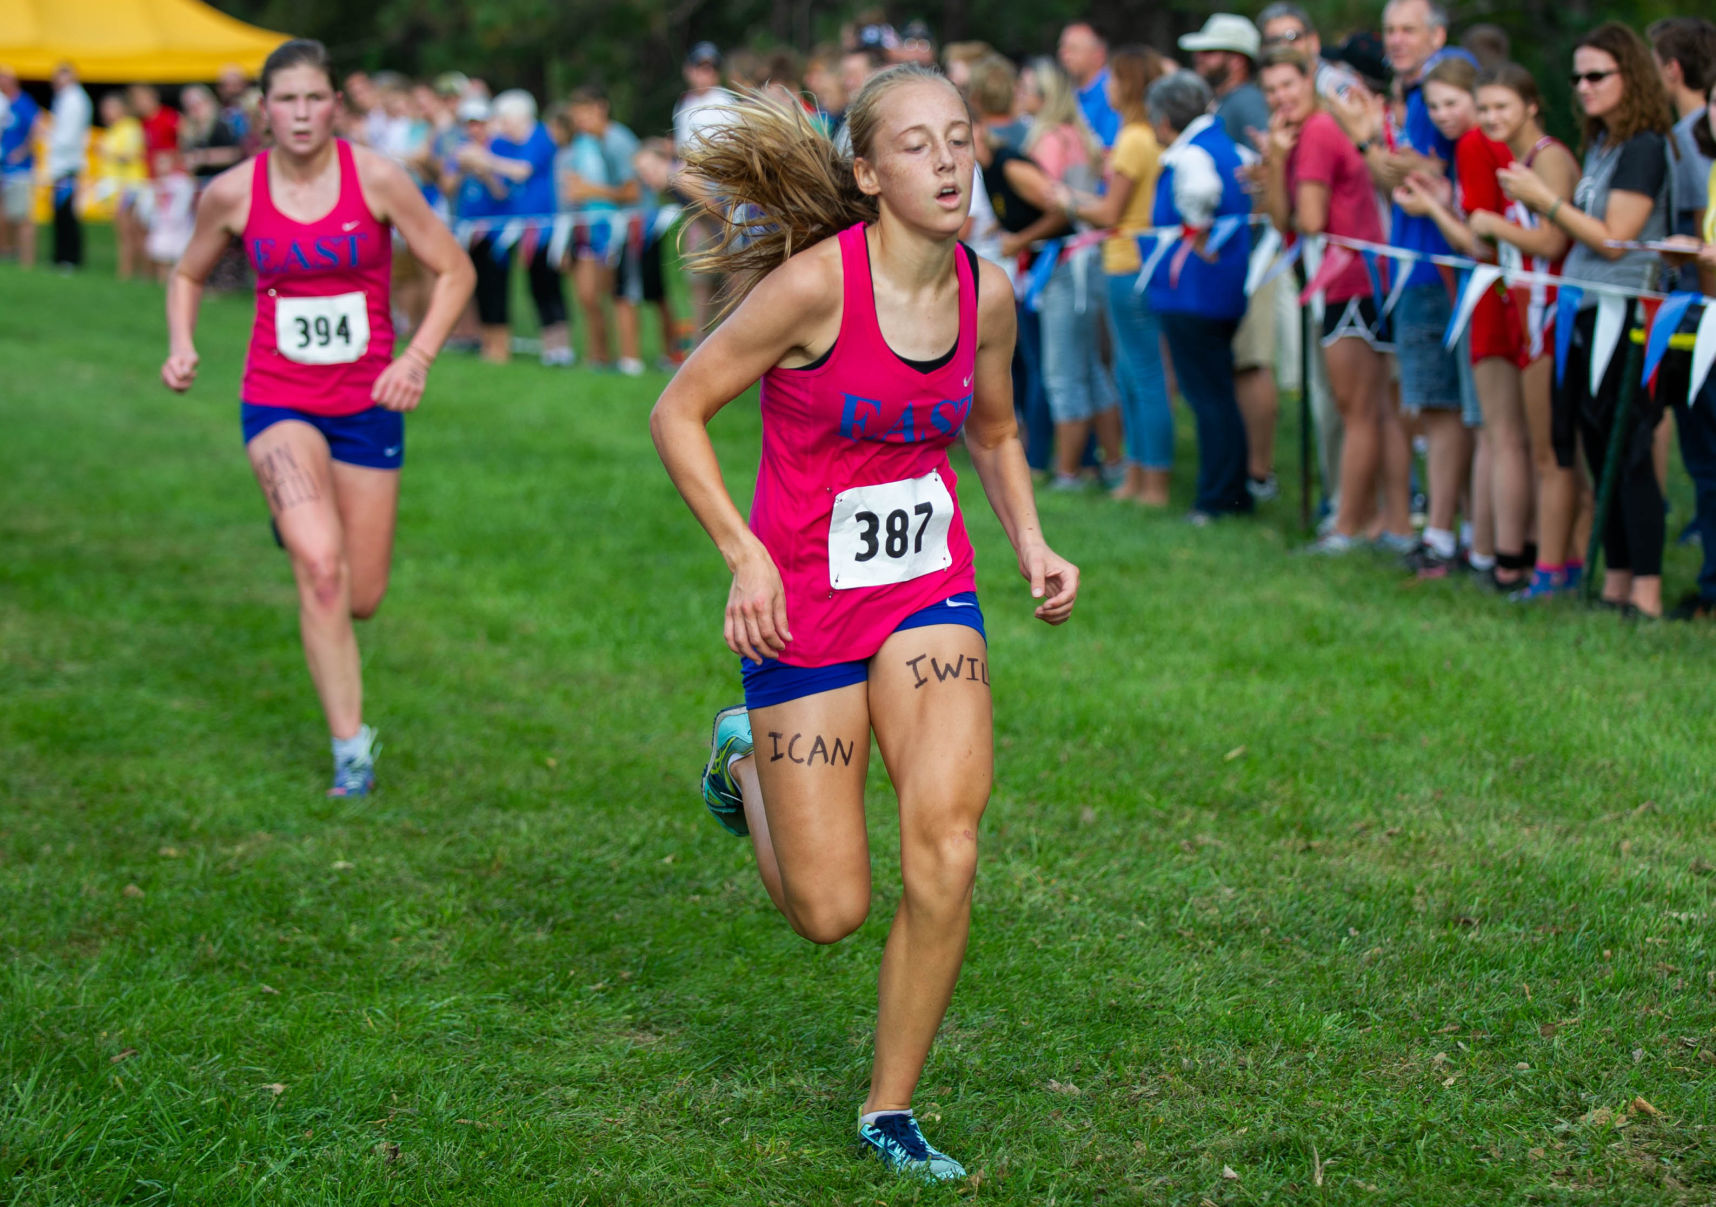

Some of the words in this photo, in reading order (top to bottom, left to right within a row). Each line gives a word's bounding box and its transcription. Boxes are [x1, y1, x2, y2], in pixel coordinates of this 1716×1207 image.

[253, 234, 366, 273] EAST
[294, 314, 351, 348] 394
[838, 391, 973, 443] EAST
[854, 501, 934, 562] 387
